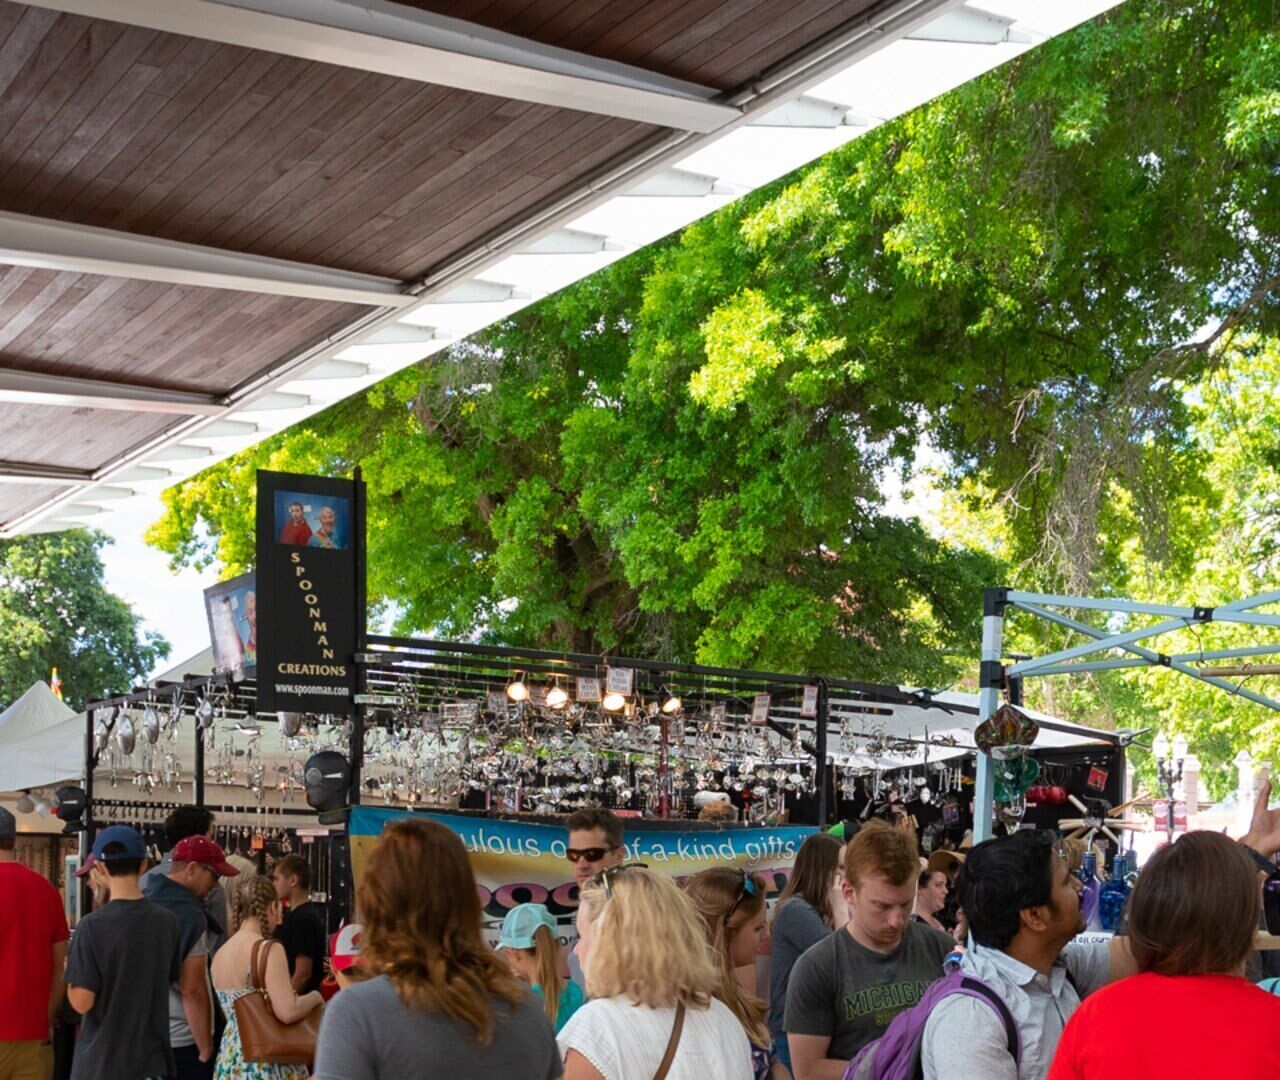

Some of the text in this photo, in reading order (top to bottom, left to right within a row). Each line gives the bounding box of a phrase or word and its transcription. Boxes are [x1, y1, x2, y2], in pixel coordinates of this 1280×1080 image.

[291, 552, 334, 659] SPOONMAN
[277, 662, 347, 677] CREATIONS
[275, 683, 349, 697] www.spoonman.com
[459, 827, 541, 858] ulous
[843, 980, 931, 1022] MICHIGA
